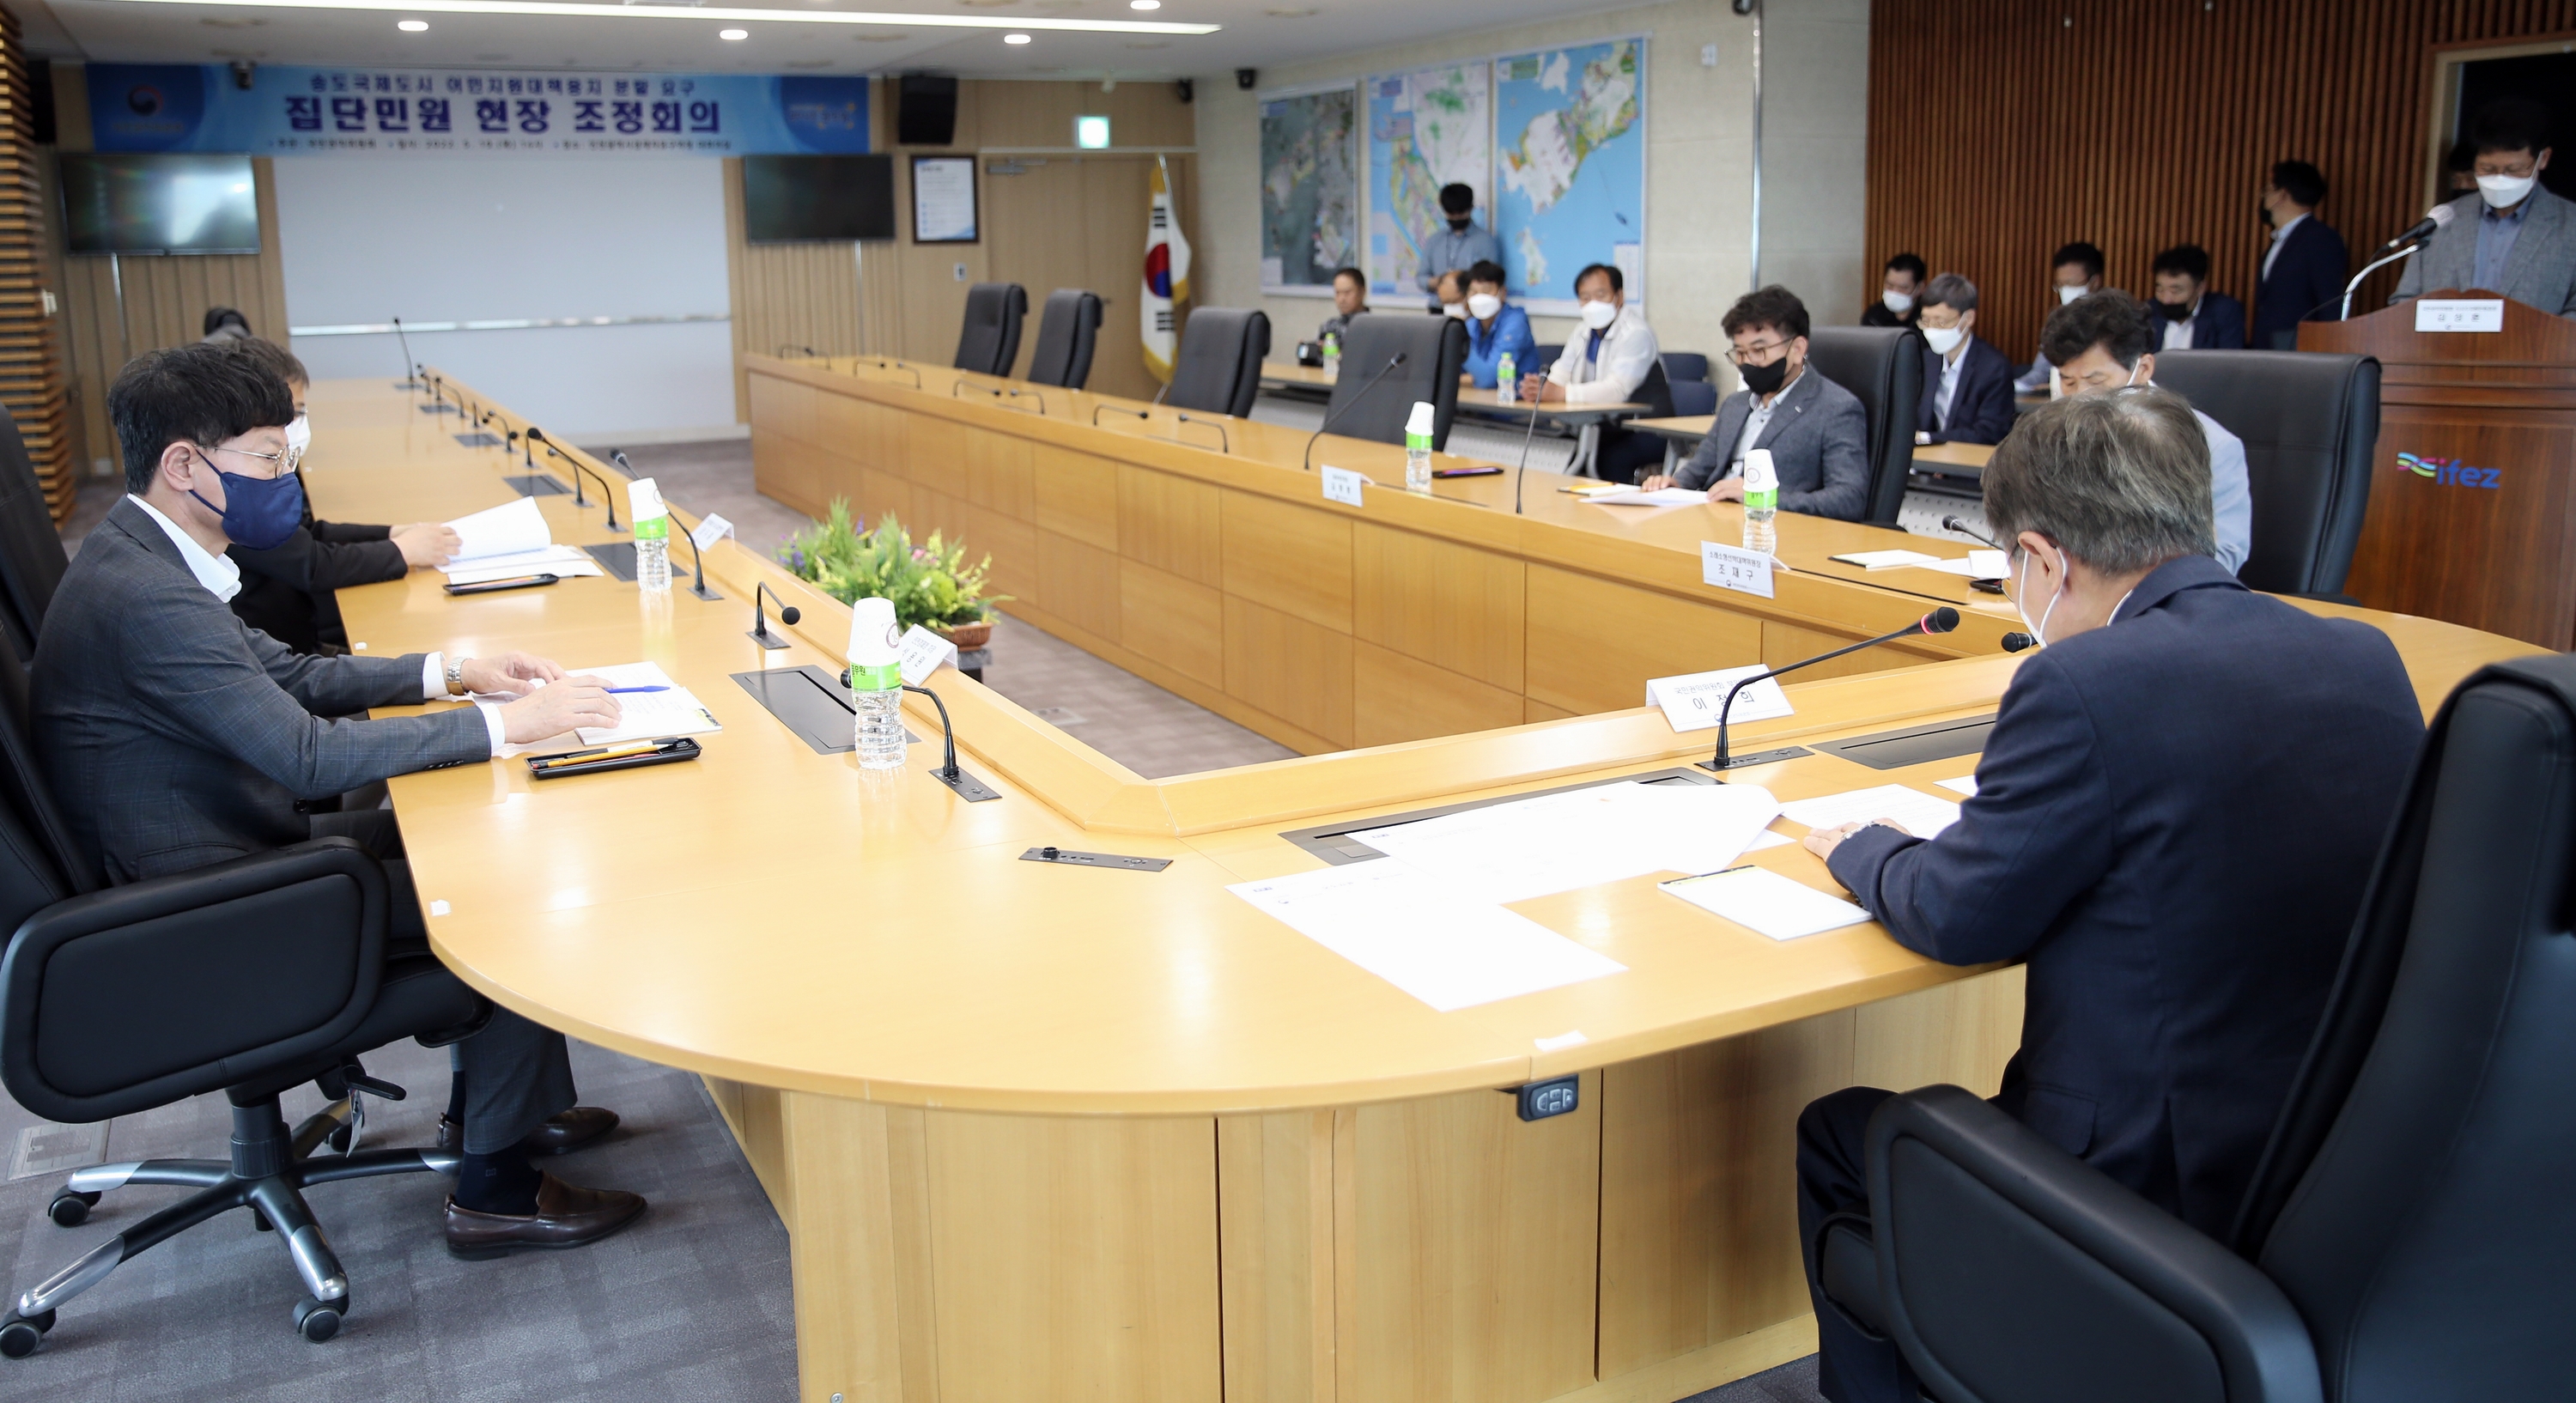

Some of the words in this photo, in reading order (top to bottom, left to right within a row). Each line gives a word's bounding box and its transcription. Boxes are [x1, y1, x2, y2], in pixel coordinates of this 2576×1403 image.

[311, 74, 434, 94] 송도국제도시
[446, 76, 603, 96] 어민지원대책용지
[660, 80, 696, 97] 요구
[284, 96, 452, 132] 집단민원
[476, 98, 551, 134] 현장
[574, 99, 720, 135] 조정회의
[2436, 457, 2501, 489] ifez
[1674, 682, 1725, 695] 국민권익위원회
[1692, 697, 1708, 710] 이
